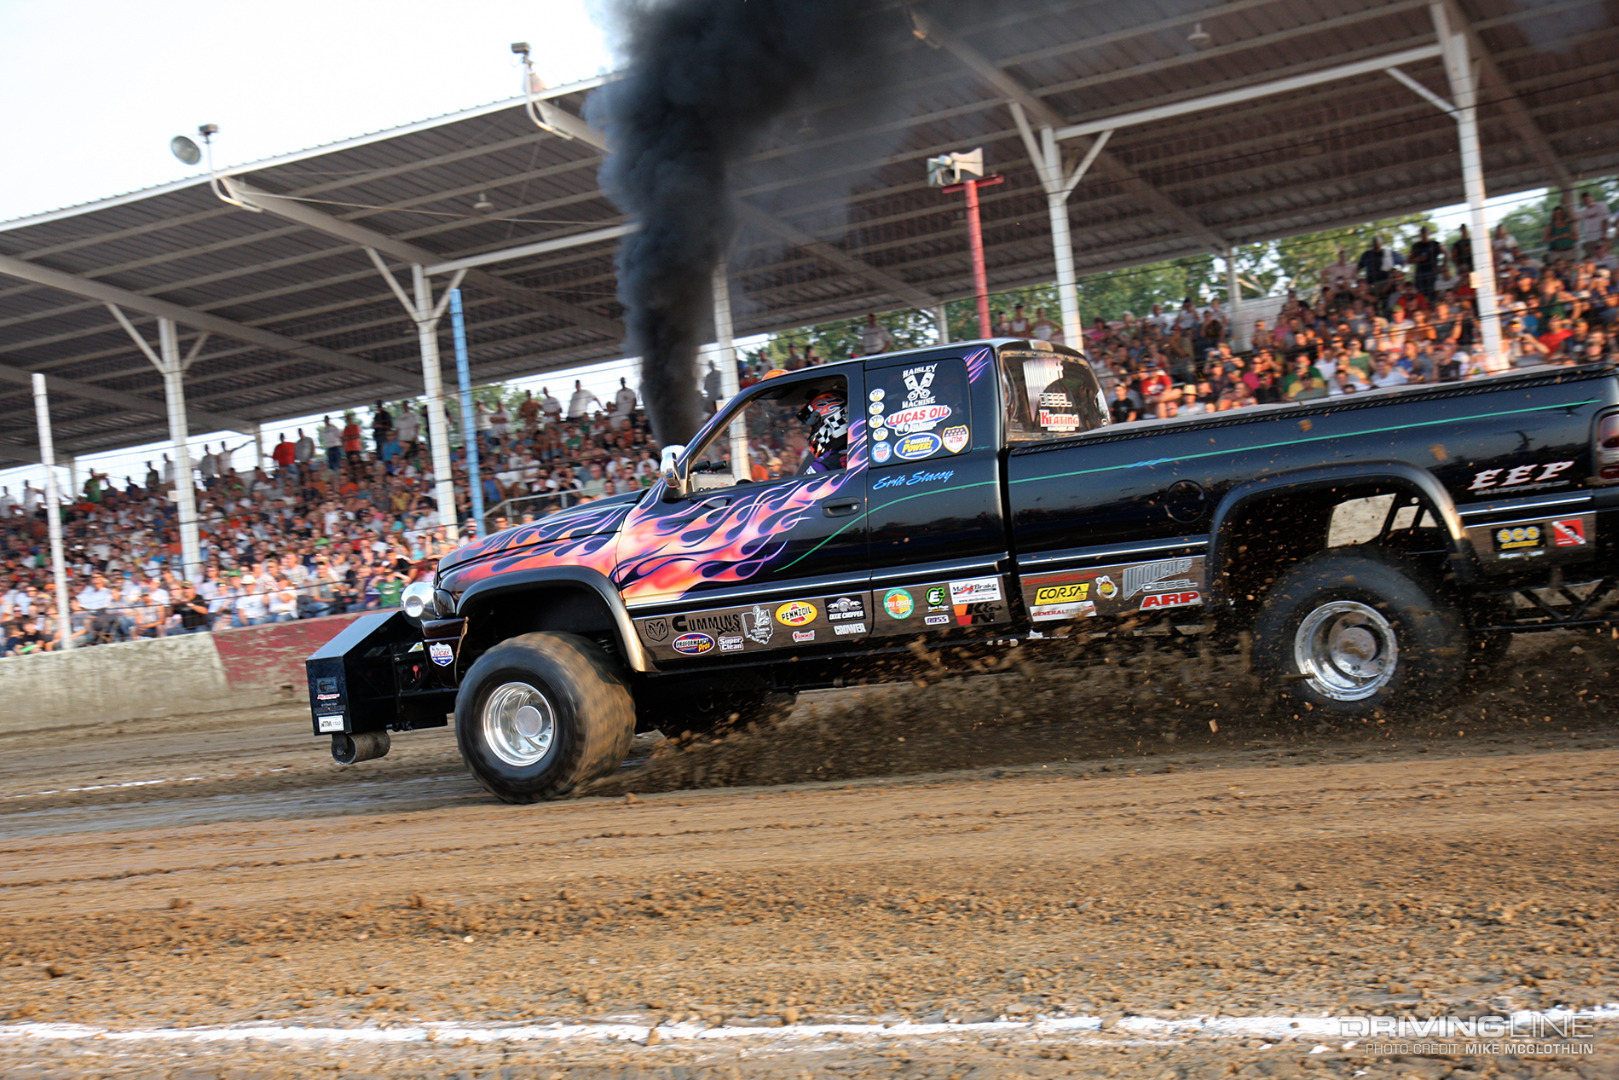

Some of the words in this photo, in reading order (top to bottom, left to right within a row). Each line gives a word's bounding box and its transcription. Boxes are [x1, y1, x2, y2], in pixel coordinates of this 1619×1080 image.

[902, 363, 938, 379] HAISLEY
[902, 395, 936, 409] MACHINE
[889, 409, 926, 426] LUCAS
[929, 406, 949, 420] OIL
[872, 474, 906, 490] Erik
[906, 470, 955, 486] Stacey
[1467, 460, 1575, 490] EEP
[1499, 526, 1540, 542] SCS
[1039, 585, 1088, 600] CORSA
[1143, 579, 1198, 592] DIESEL
[1142, 591, 1200, 608] ARP
[781, 606, 812, 621] PENNZOIL
[1032, 609, 1066, 617] GENERAL
[672, 614, 739, 632] CUMMINS
[720, 637, 741, 645] Super
